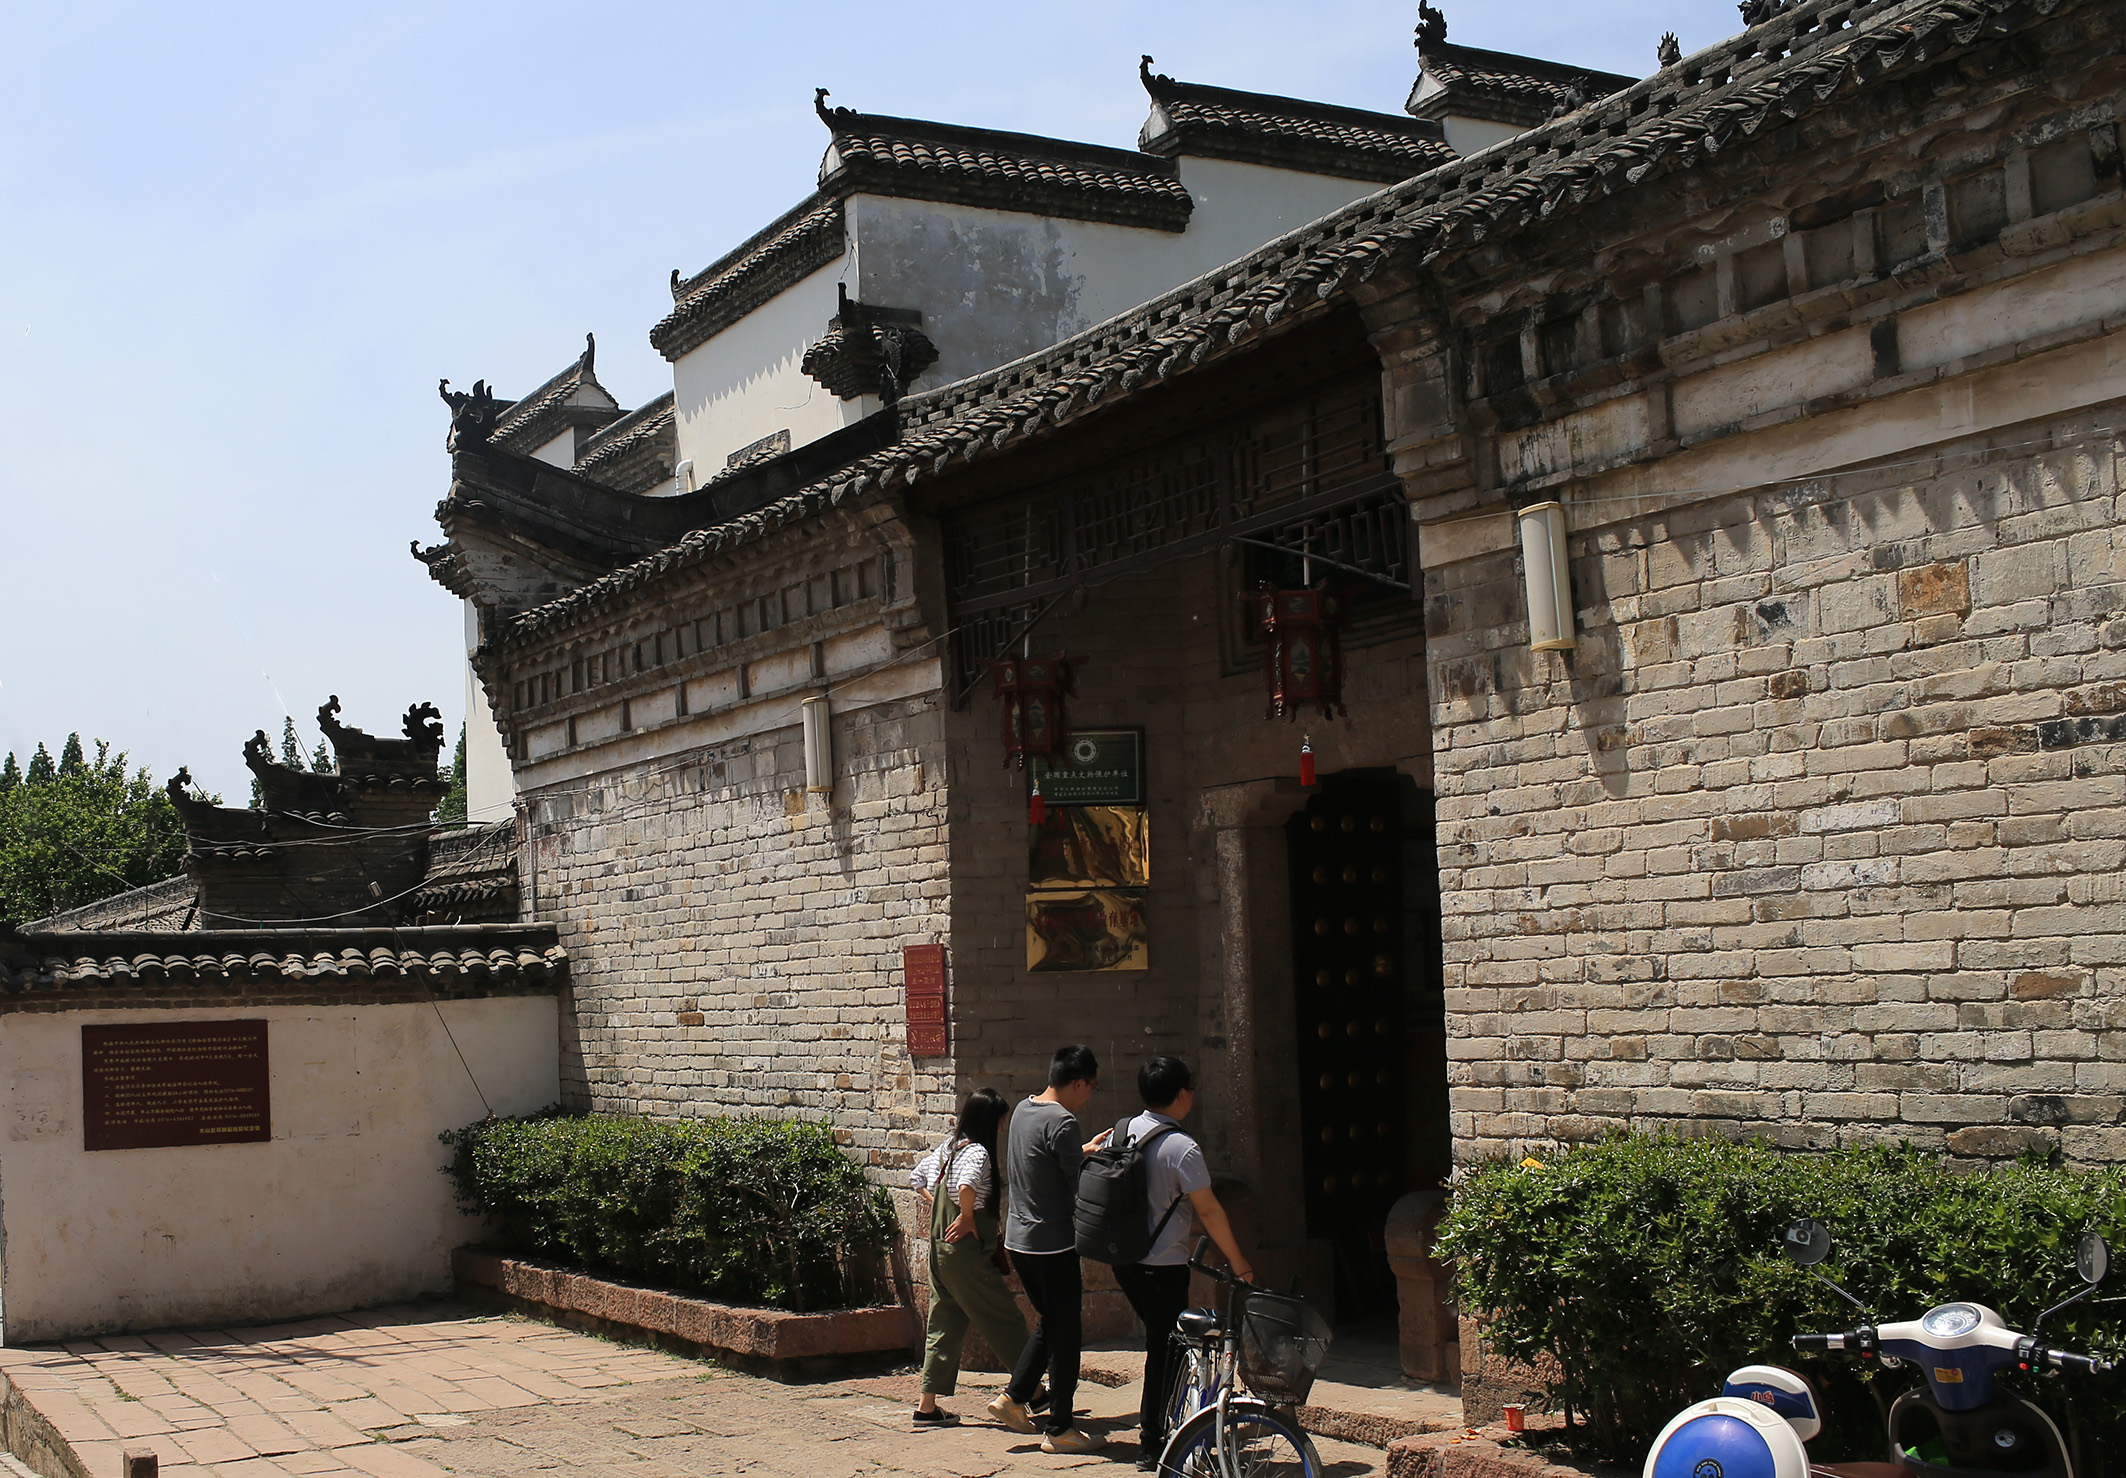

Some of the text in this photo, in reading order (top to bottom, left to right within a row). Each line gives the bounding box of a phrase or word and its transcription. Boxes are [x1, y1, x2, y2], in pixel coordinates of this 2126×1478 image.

[1044, 770, 1128, 780] 全国重点文物保护单位
